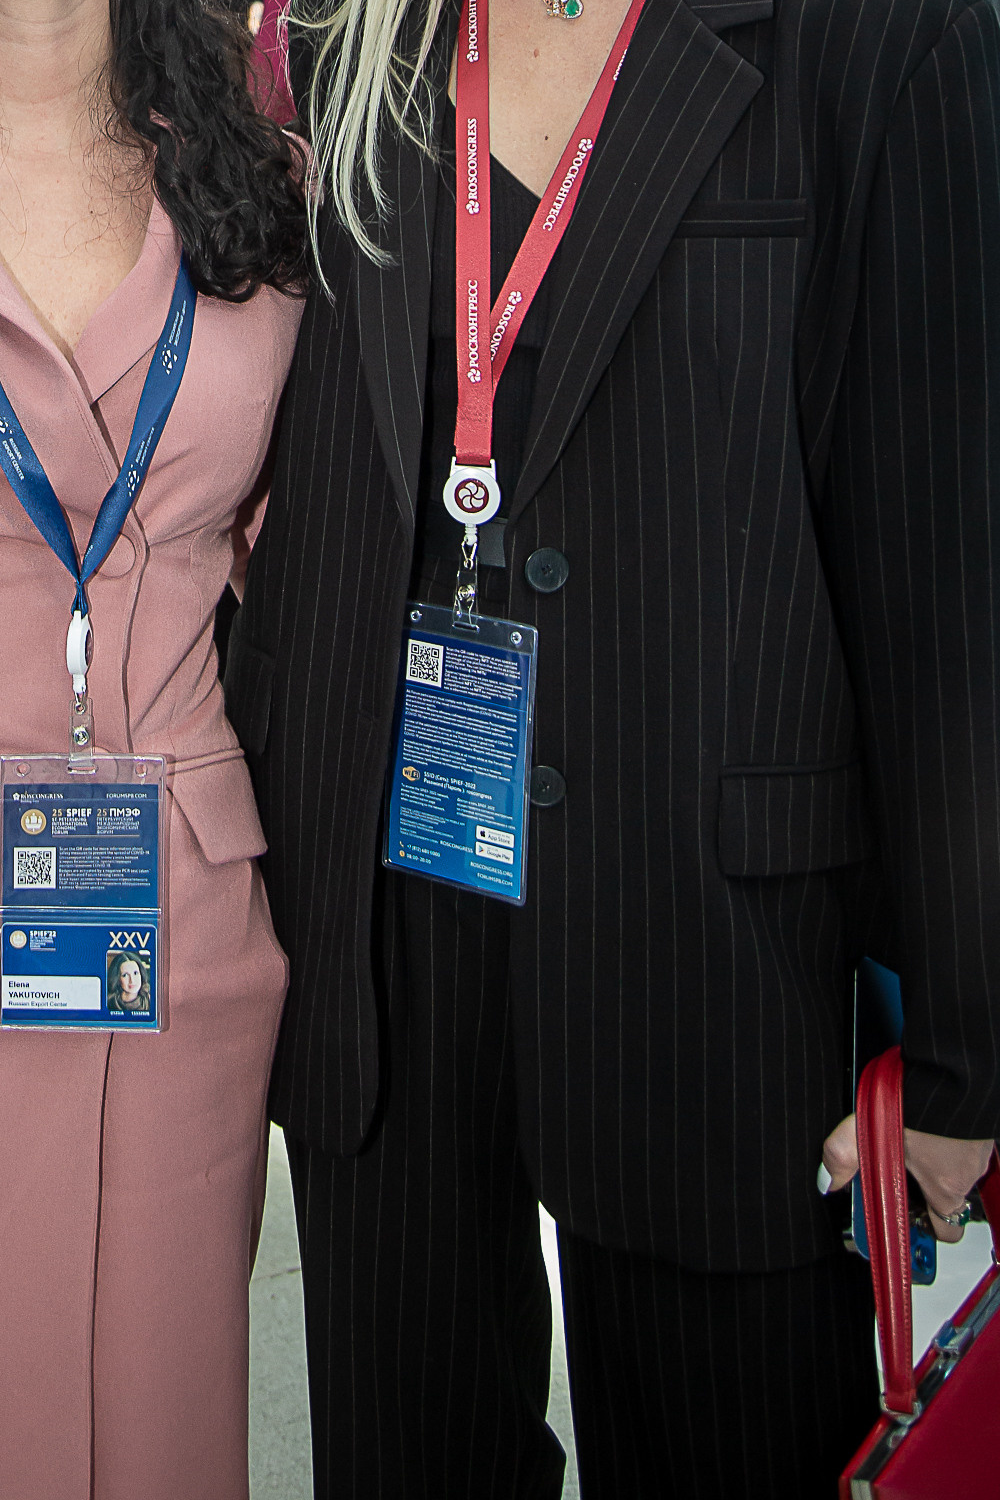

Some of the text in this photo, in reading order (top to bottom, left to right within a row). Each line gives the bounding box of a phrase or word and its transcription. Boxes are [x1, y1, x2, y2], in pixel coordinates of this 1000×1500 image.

[467, 118, 478, 200] ROSCONGRESS
[542, 149, 587, 232] РОСКОНГРЕСС
[468, 280, 479, 368] РОСКОНГРЕСС
[66, 808, 92, 817] SPIEF
[109, 808, 141, 817] ПМЭФ
[109, 931, 150, 948] XXV
[8, 991, 60, 999] YAKUTOVICH
